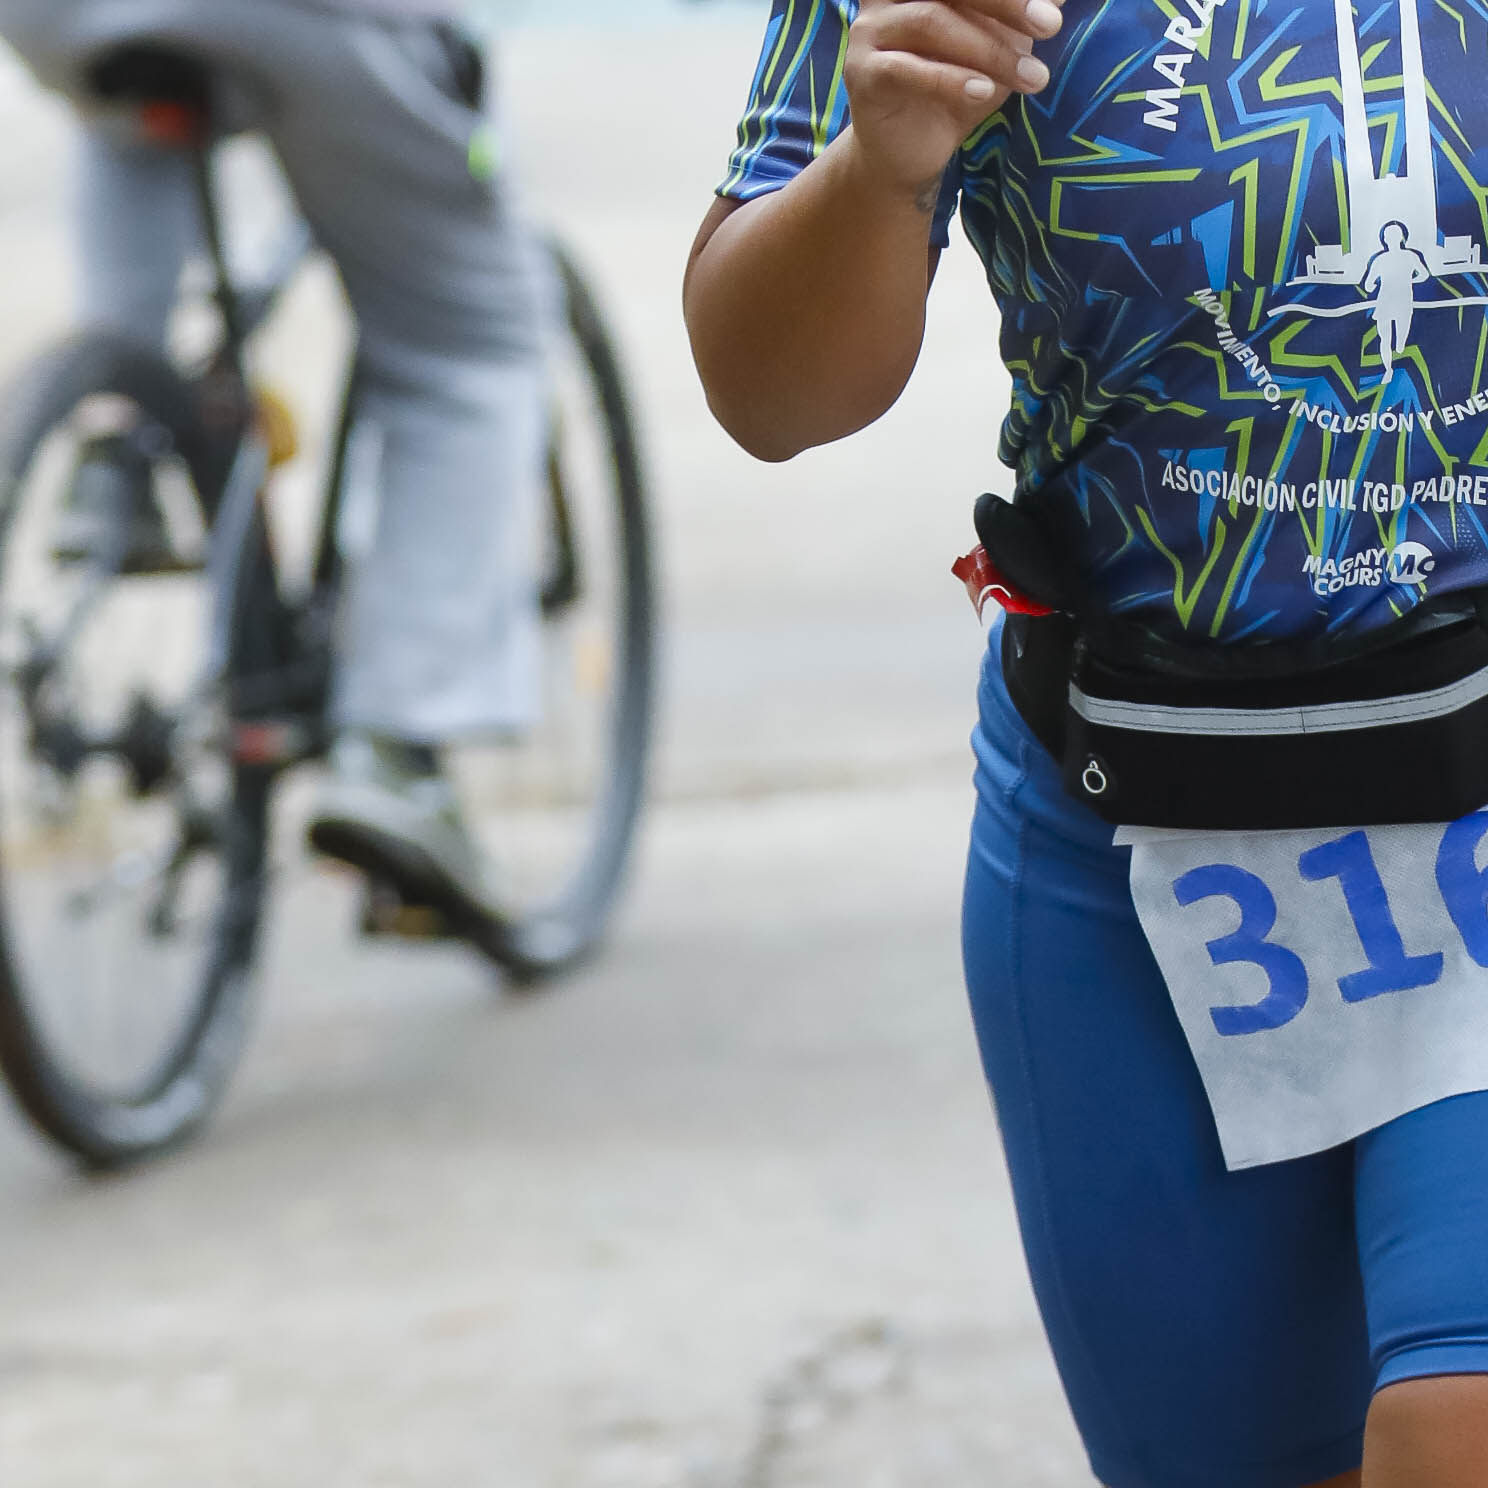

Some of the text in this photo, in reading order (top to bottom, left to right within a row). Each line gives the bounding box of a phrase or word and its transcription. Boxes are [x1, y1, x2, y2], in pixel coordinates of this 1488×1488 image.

[1288, 399, 1414, 433] INCLUSIÓN
[1418, 410, 1434, 431] Y
[1161, 460, 1296, 512] ASOCIACIÓN
[1302, 478, 1357, 512] CIVIL
[1362, 481, 1406, 513] TGD
[1302, 548, 1386, 578] MAGNY
[1314, 568, 1383, 595] COURS
